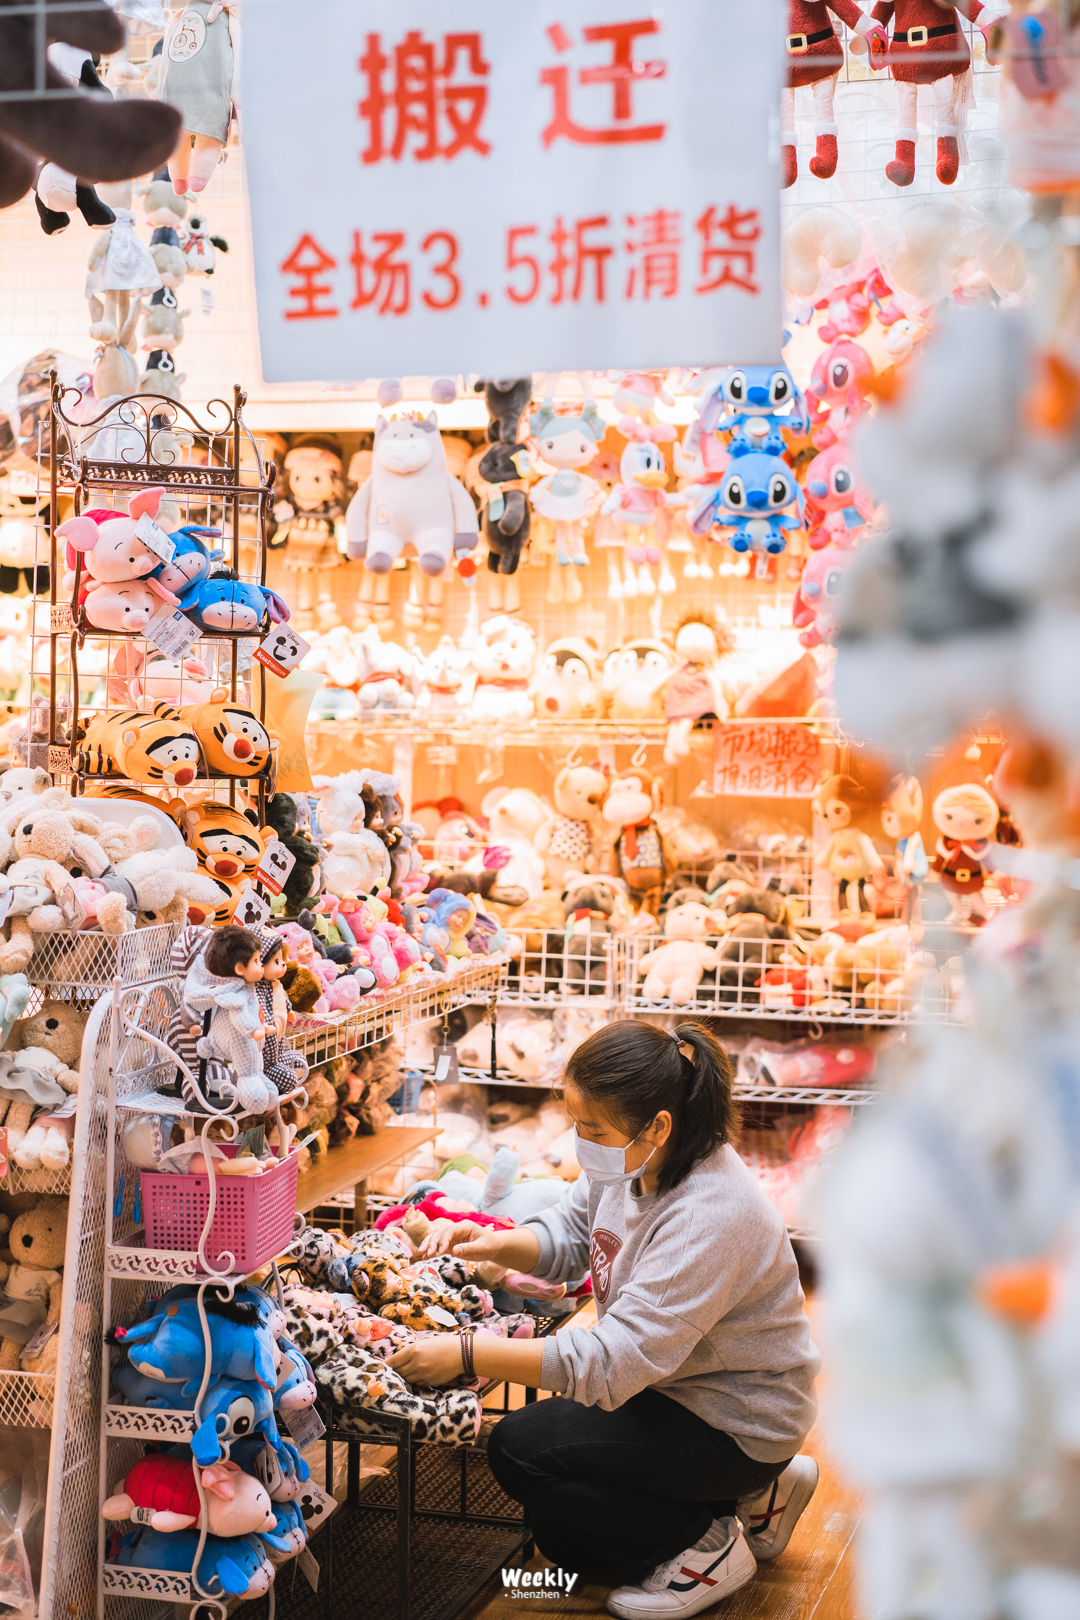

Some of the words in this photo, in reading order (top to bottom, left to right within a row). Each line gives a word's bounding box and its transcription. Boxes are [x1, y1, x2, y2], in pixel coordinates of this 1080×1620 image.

[358, 18, 667, 166] 搬迁
[280, 204, 762, 321] 全场3.5折清货
[287, 630, 300, 646] Disney
[279, 846, 289, 860] Disney
[313, 1488, 326, 1504] Disney
